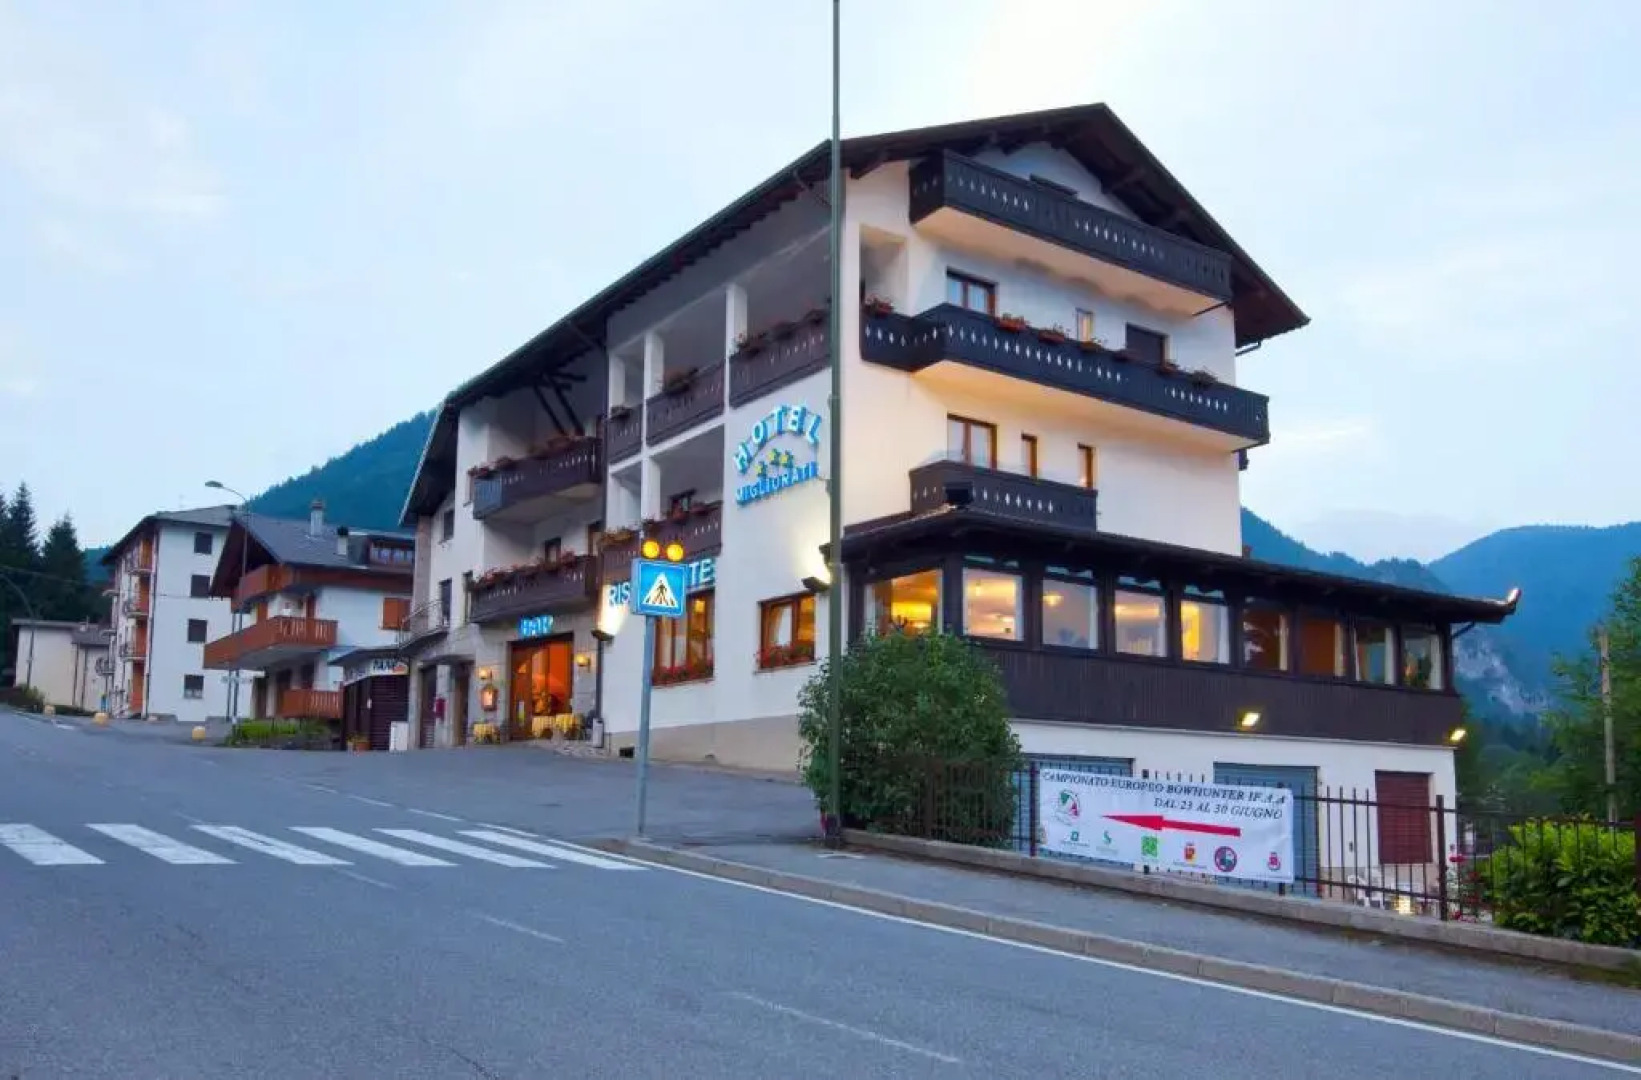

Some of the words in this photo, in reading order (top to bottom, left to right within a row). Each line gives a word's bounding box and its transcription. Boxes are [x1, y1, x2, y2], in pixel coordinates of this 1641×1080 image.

[733, 402, 821, 475] HOTEL
[1042, 769, 1108, 788] CAMPIONATO
[1111, 778, 1164, 794] EUROPEO
[1166, 784, 1245, 801] BOWHUNTER
[1153, 797, 1176, 809] DAL
[1196, 802, 1211, 814] AL
[1213, 804, 1229, 815] 30
[1230, 805, 1283, 820] GIUGNO
